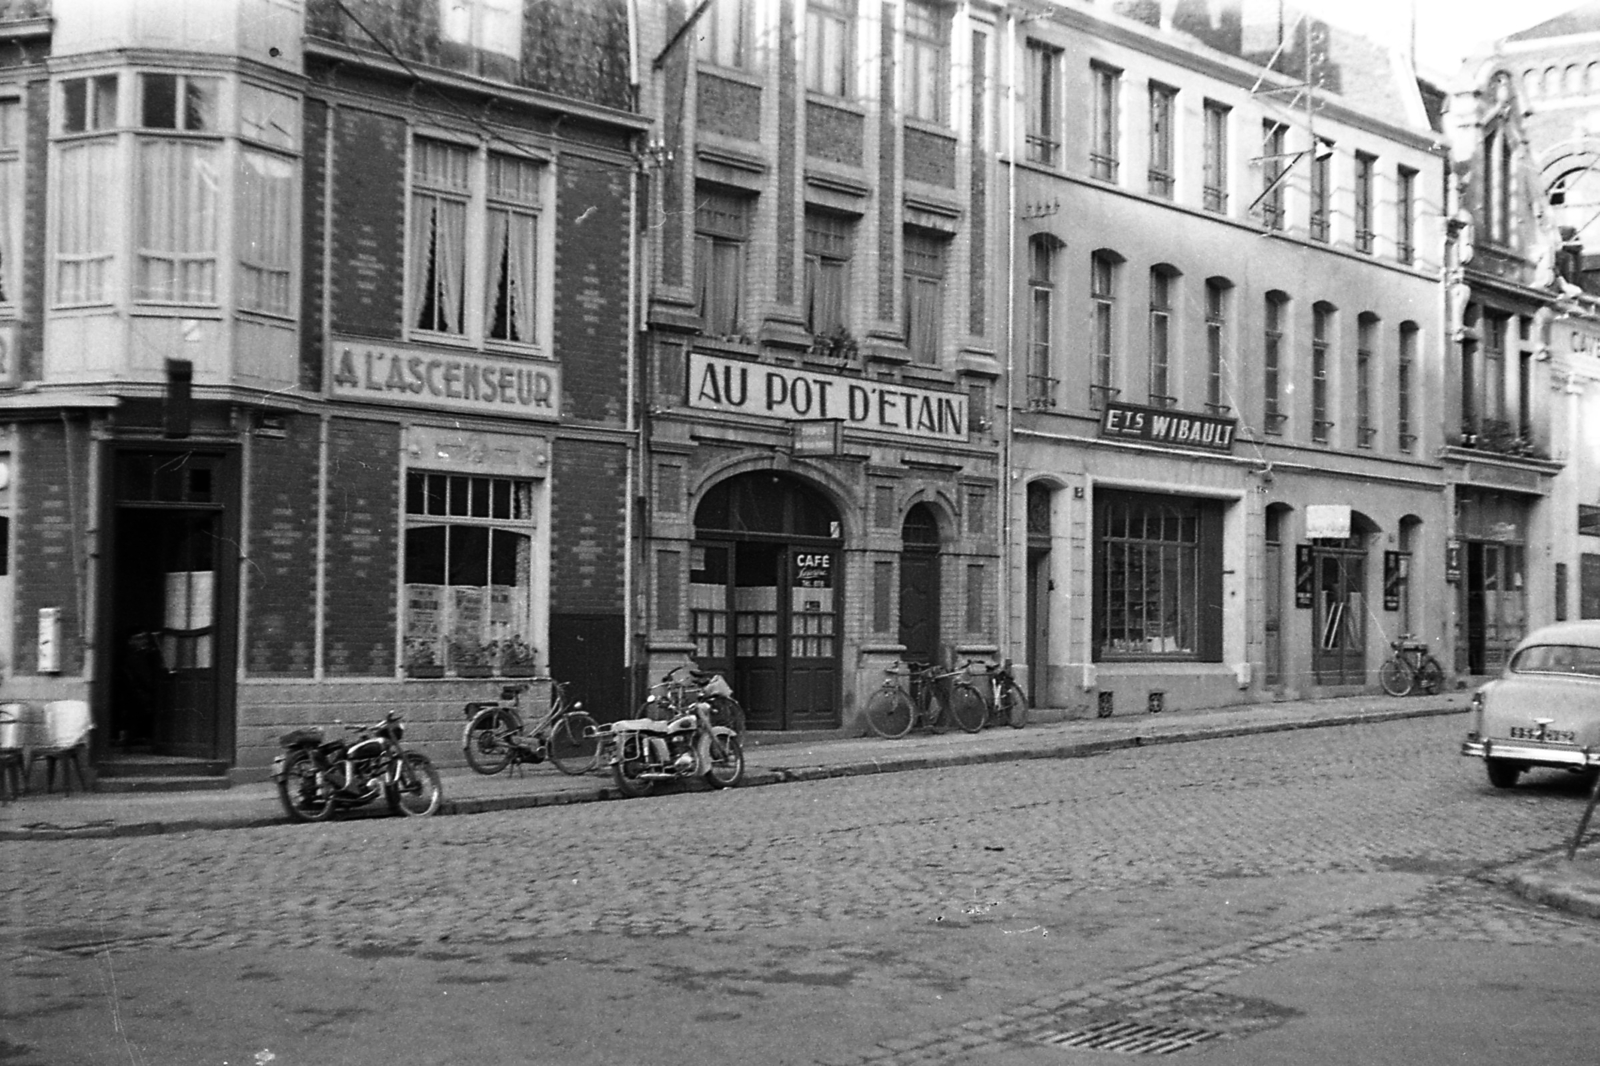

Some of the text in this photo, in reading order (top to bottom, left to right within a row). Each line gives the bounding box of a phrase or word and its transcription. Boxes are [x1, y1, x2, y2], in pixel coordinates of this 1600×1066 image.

[334, 349, 552, 408] A L'ASCENSEUR
[699, 362, 961, 434] AU POT D'ETAIN
[1152, 415, 1234, 445] WIBAULT
